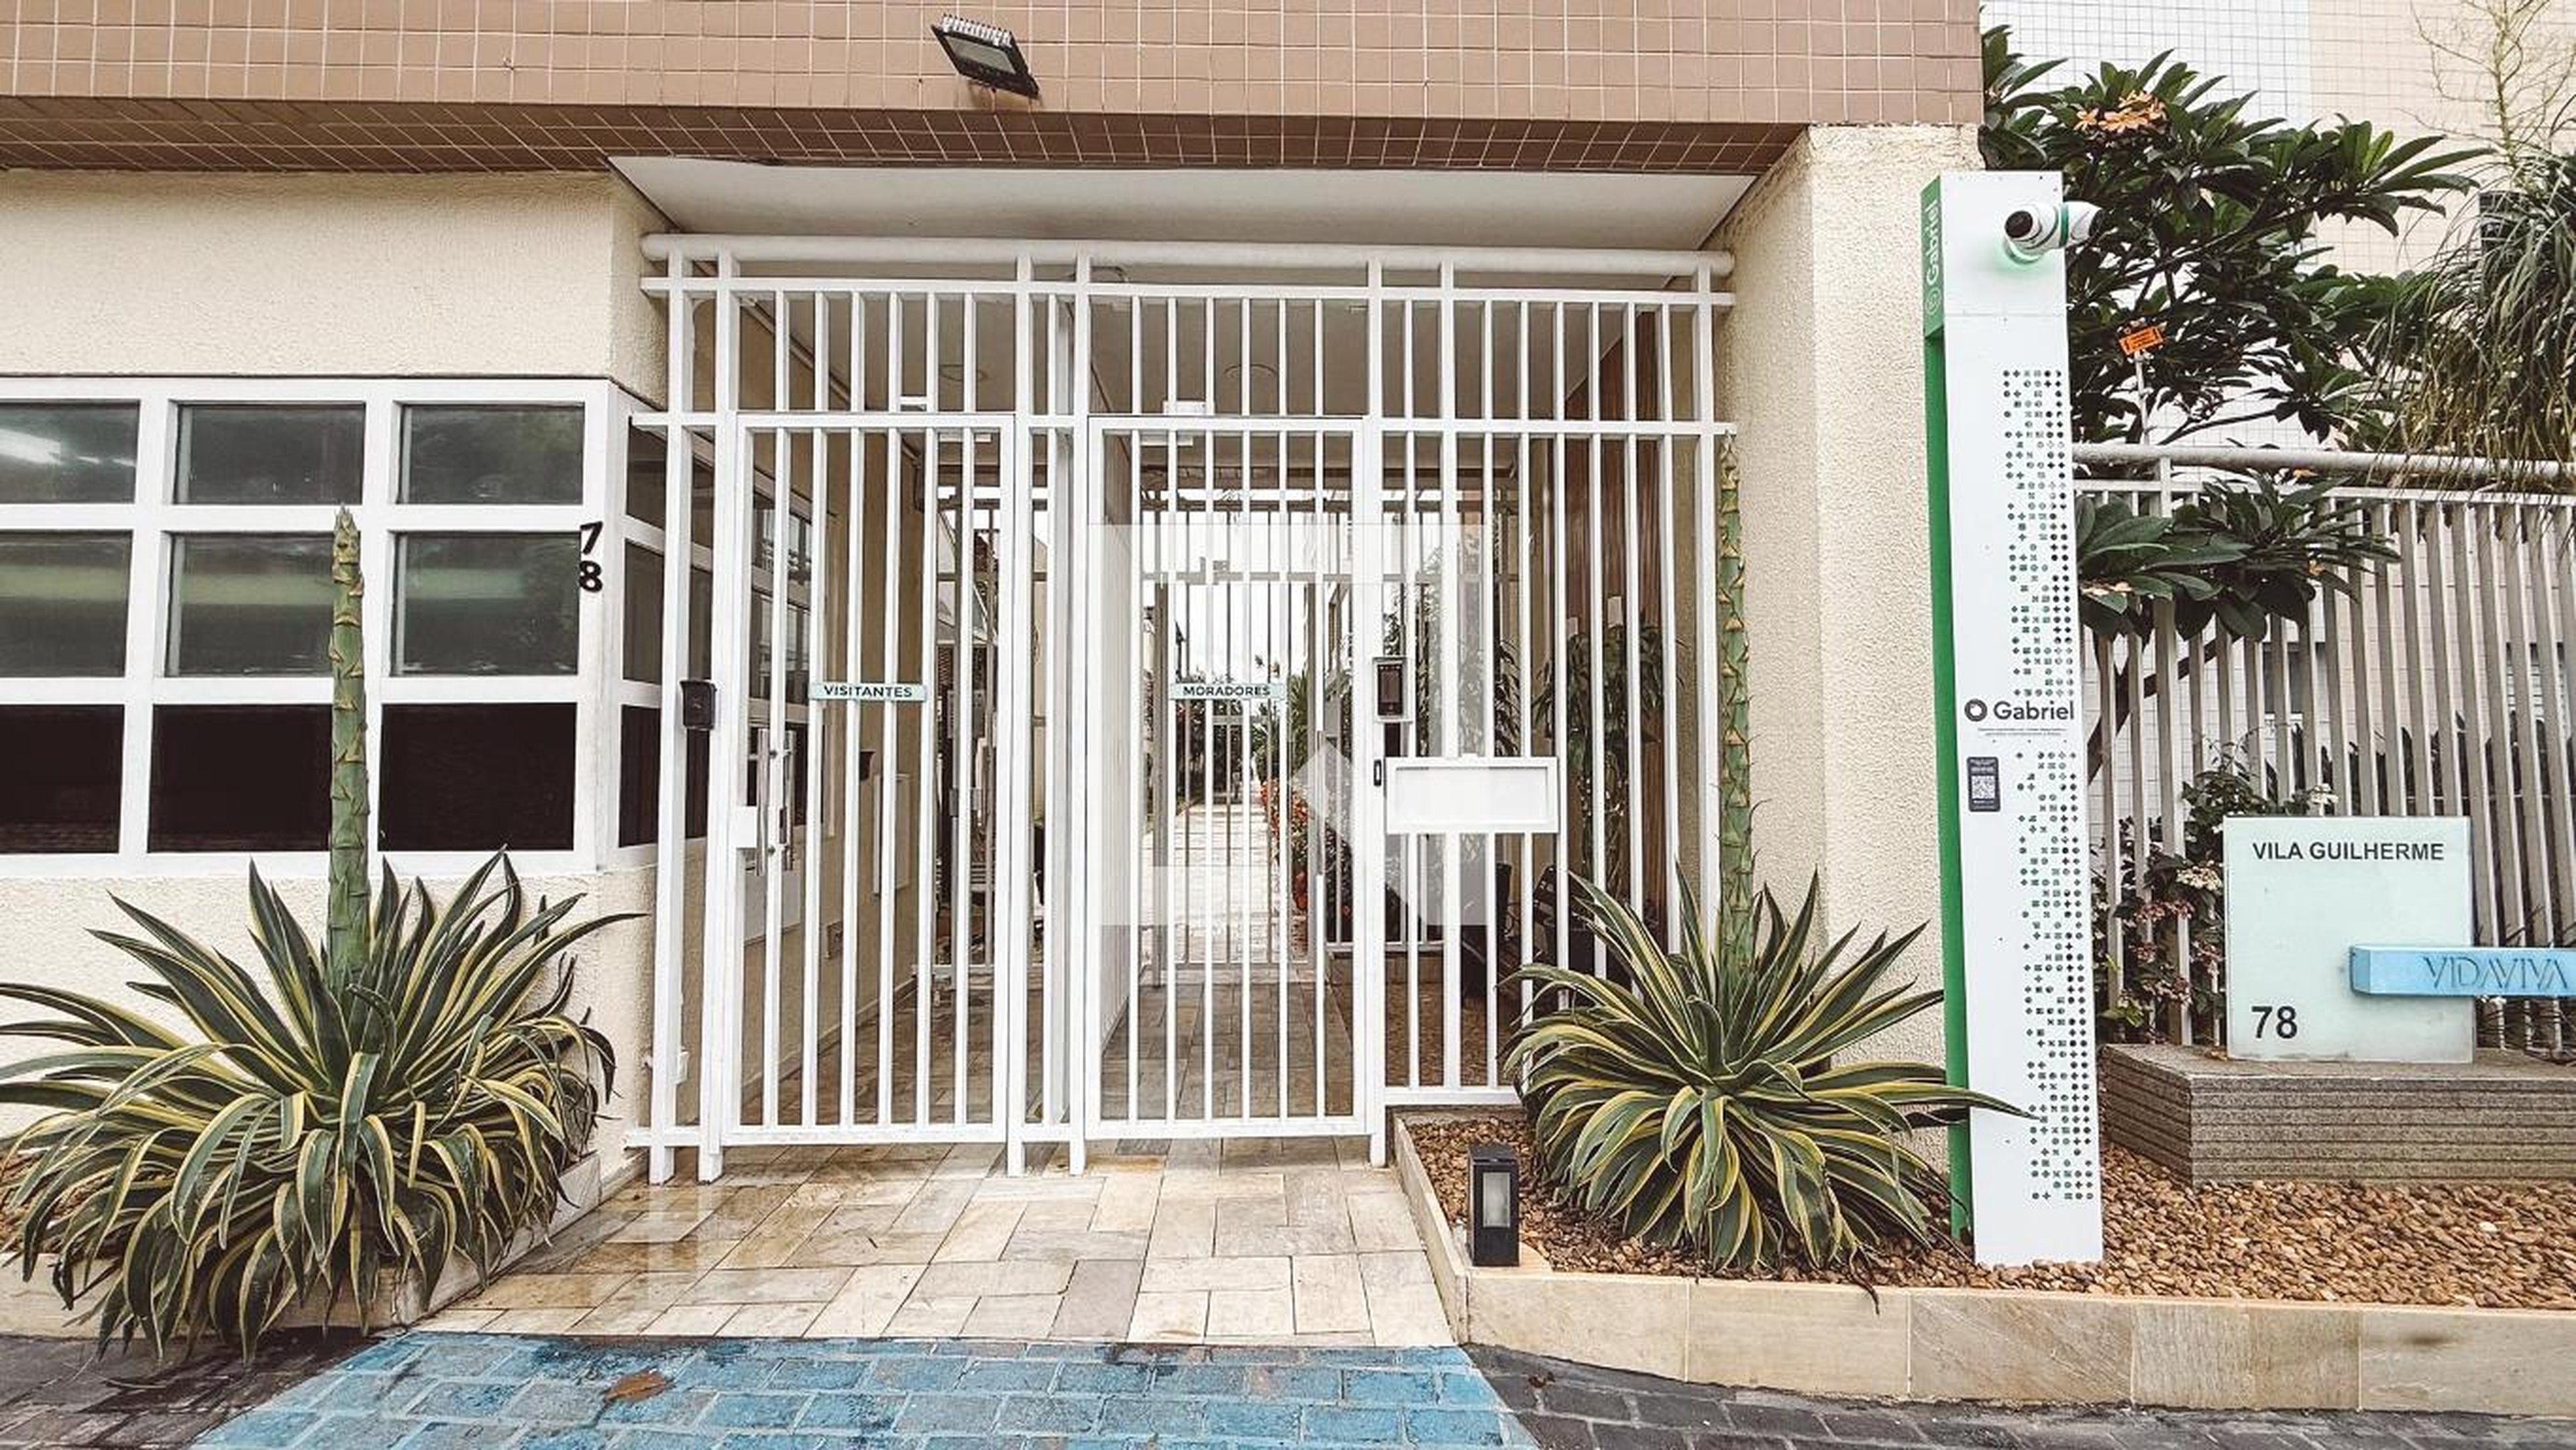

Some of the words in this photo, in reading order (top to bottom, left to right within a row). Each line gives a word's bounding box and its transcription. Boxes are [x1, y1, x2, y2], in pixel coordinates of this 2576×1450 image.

[1925, 199, 1939, 285] Gabriel
[824, 685, 912, 697] VISITANTES
[1183, 686, 1271, 696] MORADORES
[1993, 701, 2074, 720] Gabriel
[2253, 842, 2303, 860] VILA
[2310, 841, 2444, 860] GUILHERME
[2251, 1006, 2298, 1039] 78
